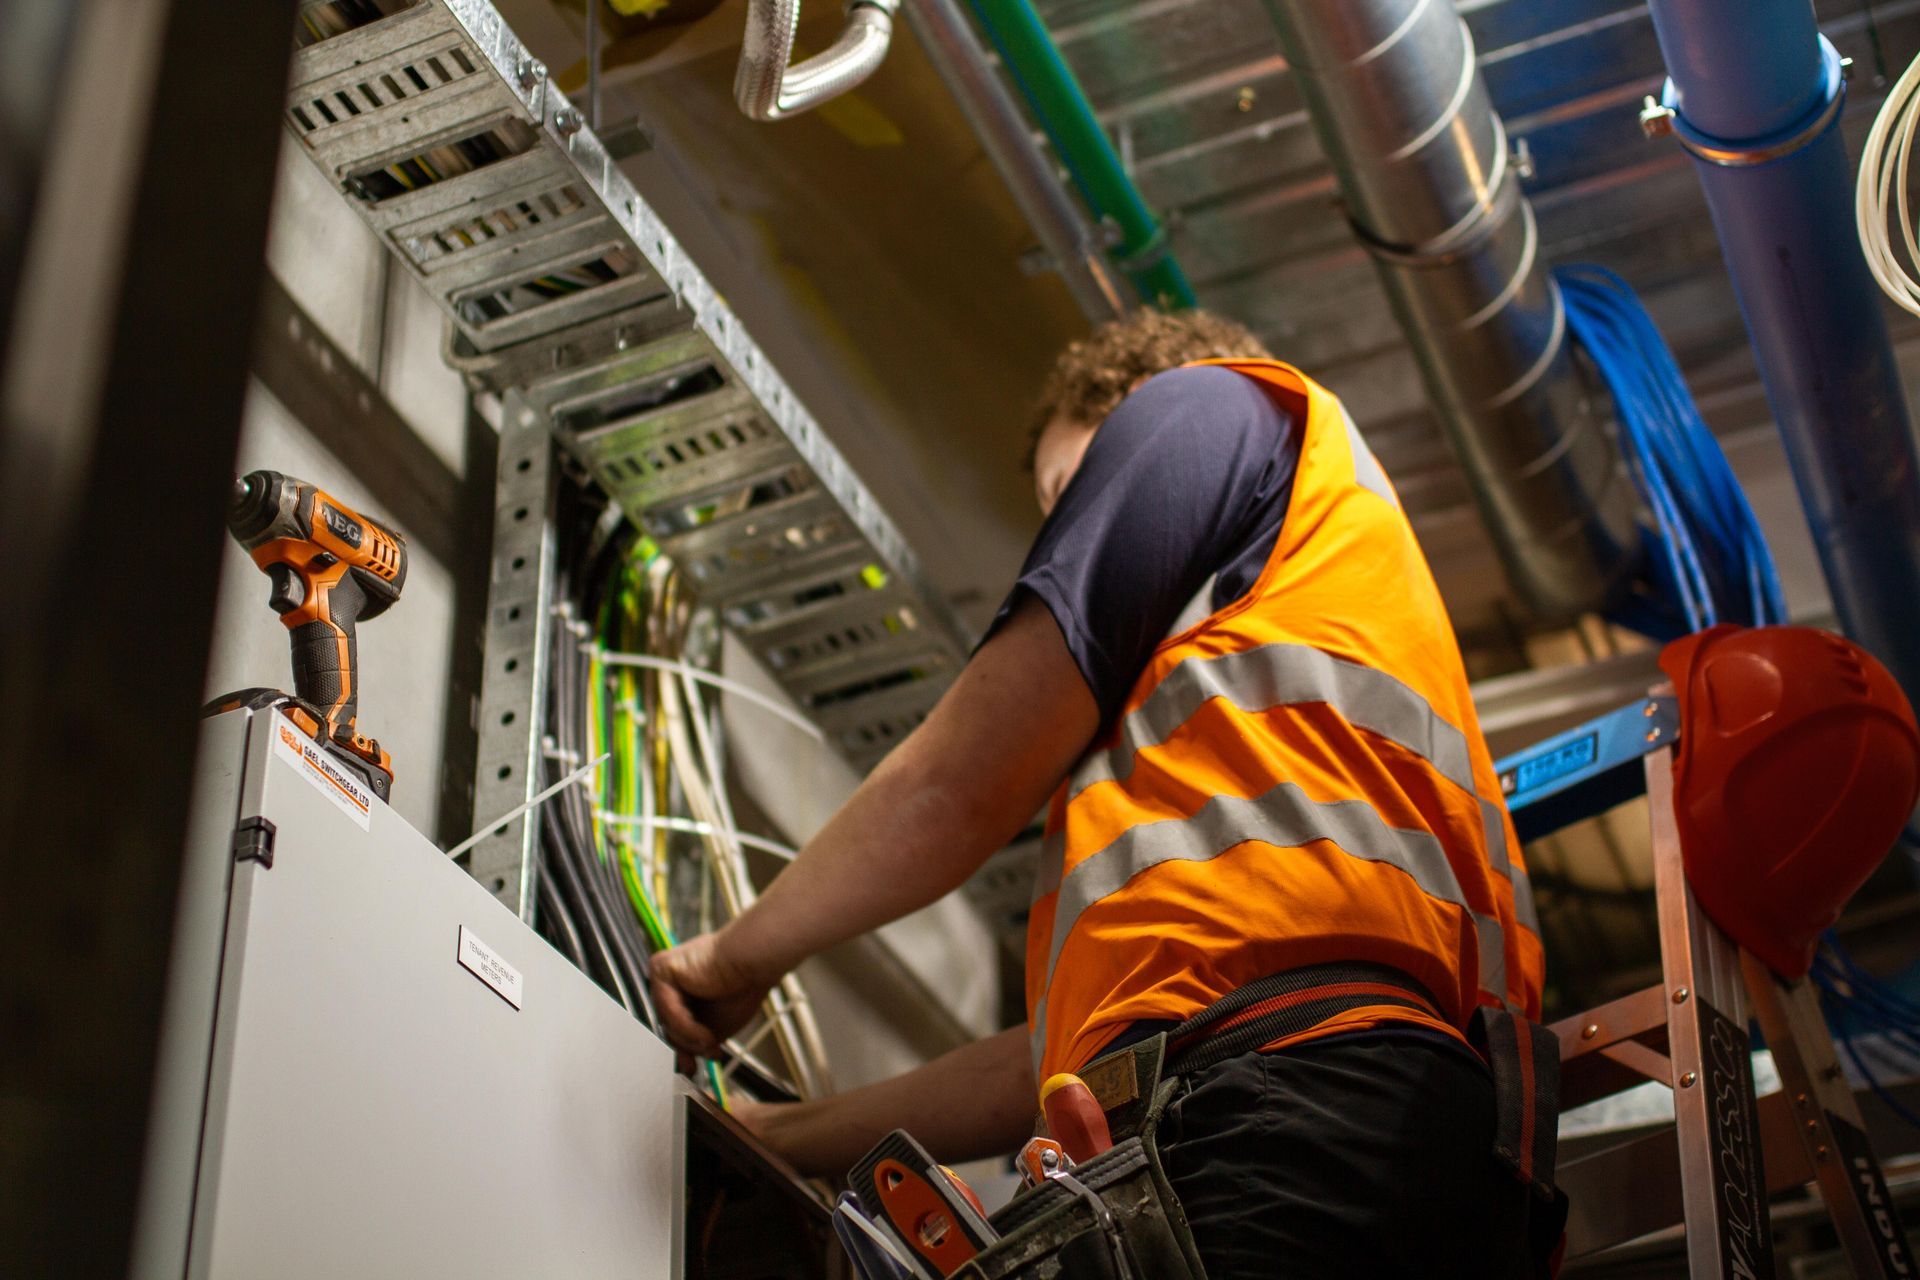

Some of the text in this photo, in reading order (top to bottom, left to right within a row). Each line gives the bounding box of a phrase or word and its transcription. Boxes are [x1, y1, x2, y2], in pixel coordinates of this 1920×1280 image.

[323, 507, 361, 541] AEG
[304, 745, 370, 808] GAEL SWITCHGEAR LTD
[469, 941, 515, 985] TENANT REVENUE
[481, 962, 502, 985] METERS
[1855, 1157, 1912, 1280] INDU
